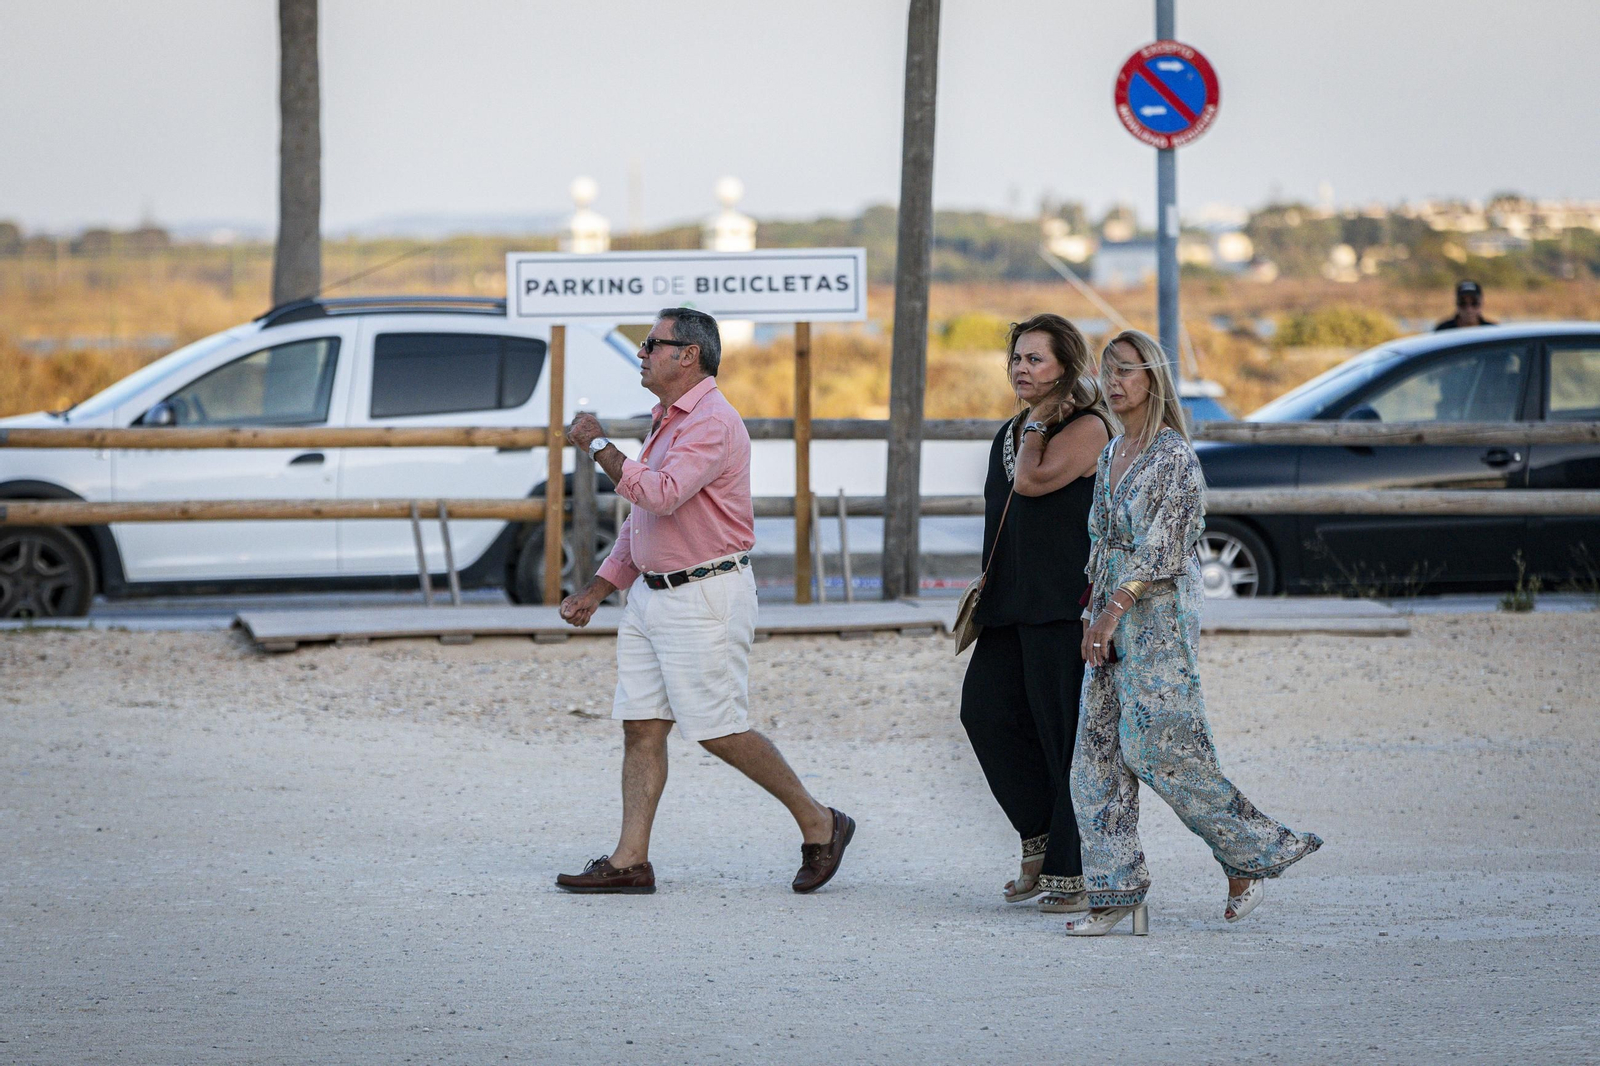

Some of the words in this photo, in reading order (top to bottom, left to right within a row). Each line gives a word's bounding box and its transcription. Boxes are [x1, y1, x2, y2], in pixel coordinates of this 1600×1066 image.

[525, 277, 643, 296] PARKING
[652, 275, 687, 294] DE
[695, 274, 850, 293] BICICLETAS
